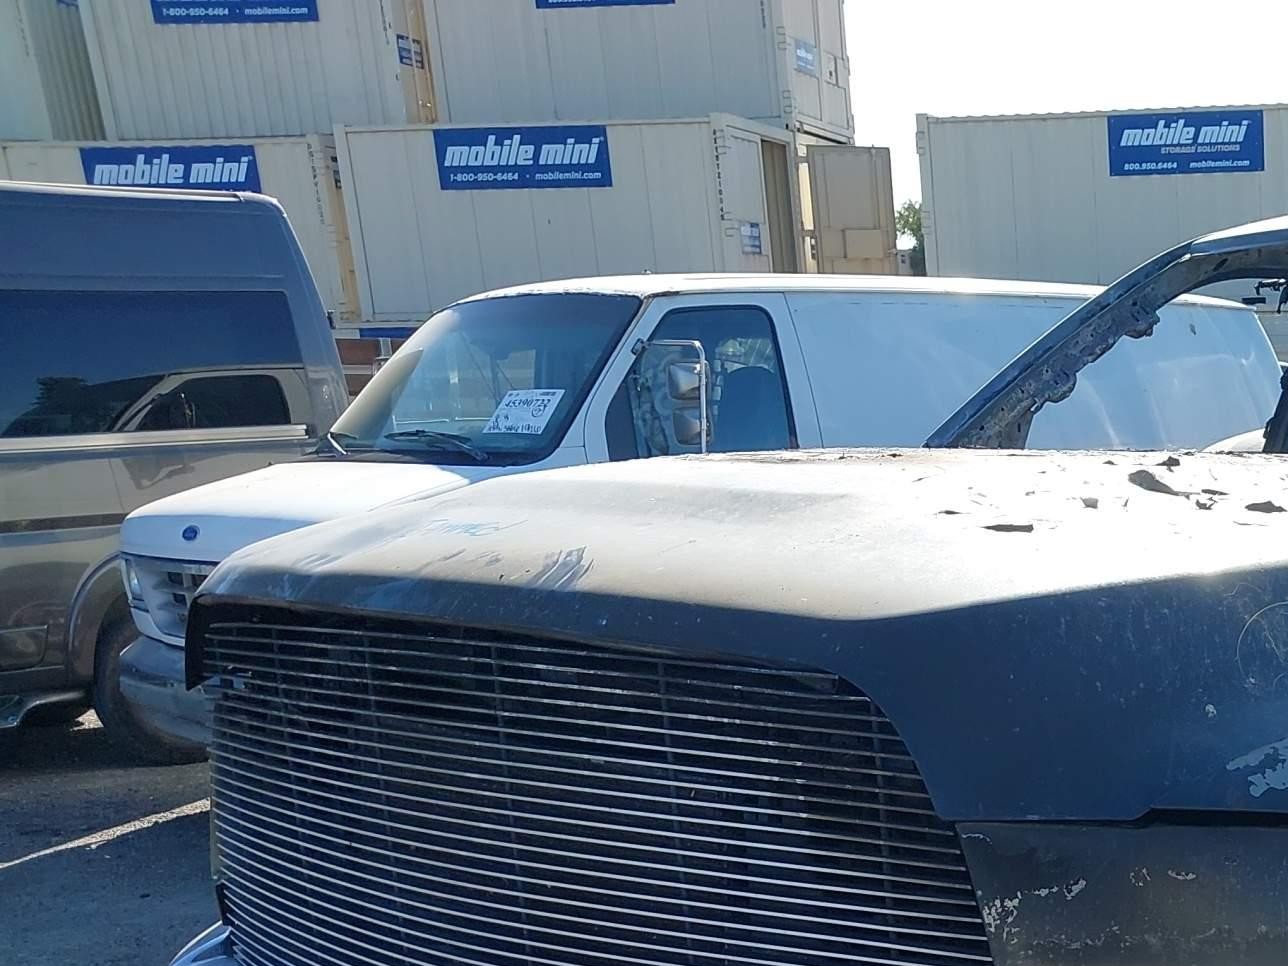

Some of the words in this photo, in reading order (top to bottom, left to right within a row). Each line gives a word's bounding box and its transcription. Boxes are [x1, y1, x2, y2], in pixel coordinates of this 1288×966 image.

[244, 7, 309, 15] mobilemini.com
[1119, 119, 1196, 147] mobile
[1197, 119, 1249, 144] mini
[444, 134, 535, 167] mobile
[538, 137, 600, 165] mini
[1197, 144, 1241, 153] SOLUTIONS
[93, 154, 184, 185] mobile
[189, 157, 249, 183] mini
[1189, 159, 1251, 169] mobilemini.com
[450, 172, 519, 182] 1-800-950-6464
[535, 170, 602, 180] mobilemini.com
